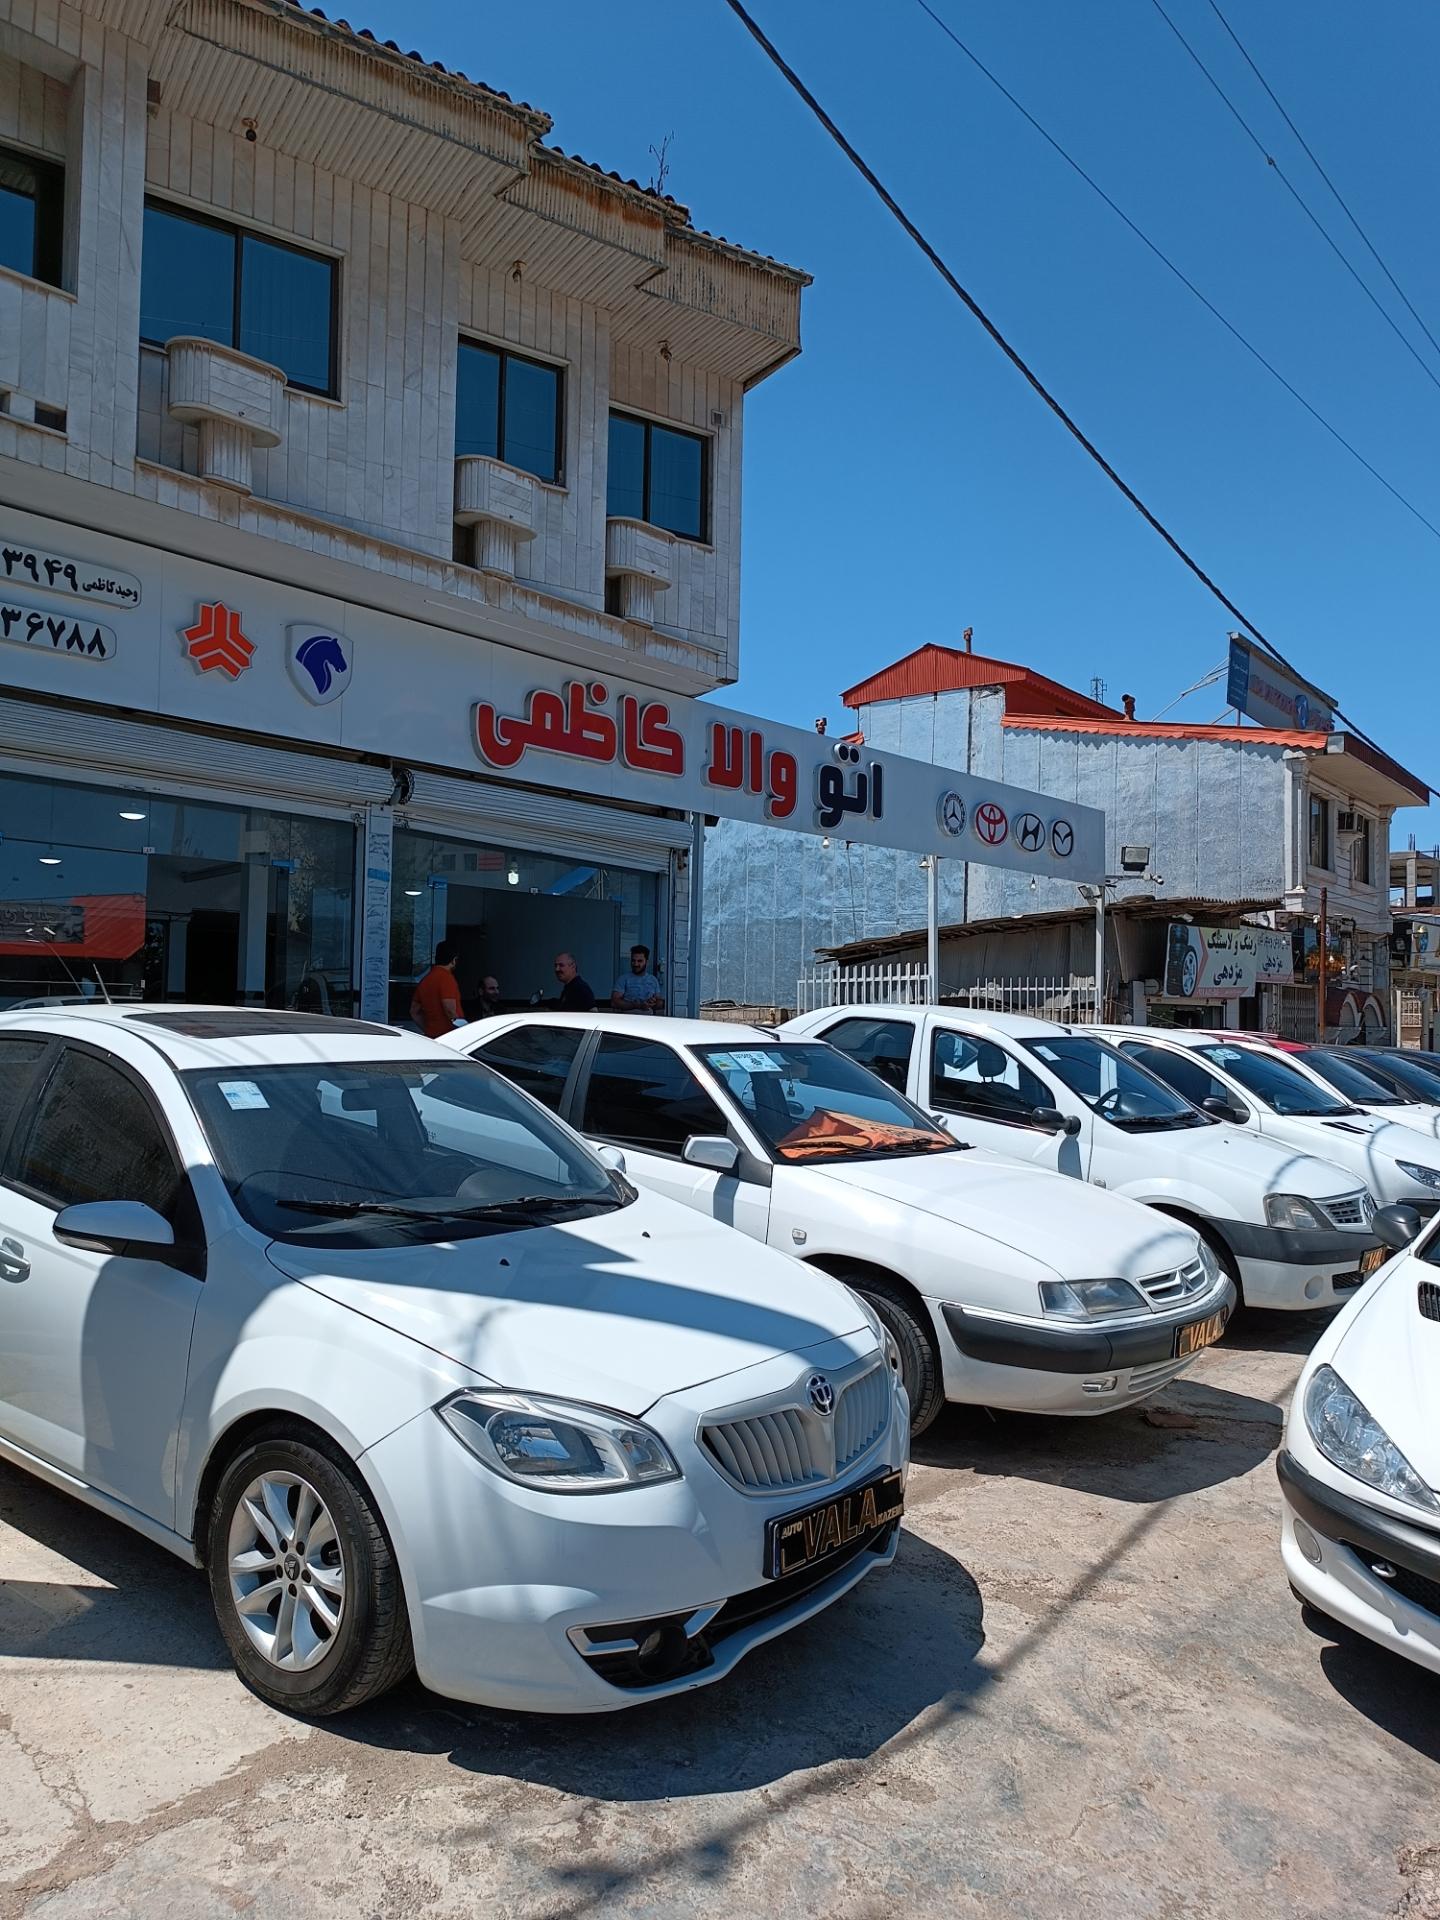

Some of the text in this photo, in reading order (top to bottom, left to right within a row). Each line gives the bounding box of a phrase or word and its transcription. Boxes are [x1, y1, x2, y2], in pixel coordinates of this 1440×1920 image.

[82, 578, 115, 593] کاظمی
[115, 584, 138, 602] وحید
[1, 606, 106, 657] ۳۶۷۸۸
[477, 681, 684, 776] کاظمی
[708, 722, 797, 818] والا
[819, 744, 882, 828] اتو
[1207, 928, 1233, 953] لاستیک
[1233, 940, 1239, 955] و
[1240, 934, 1257, 956] رینگ
[1190, 1313, 1223, 1352] VALA
[781, 1520, 803, 1539] AUTO
[801, 1487, 877, 1560] VALA
